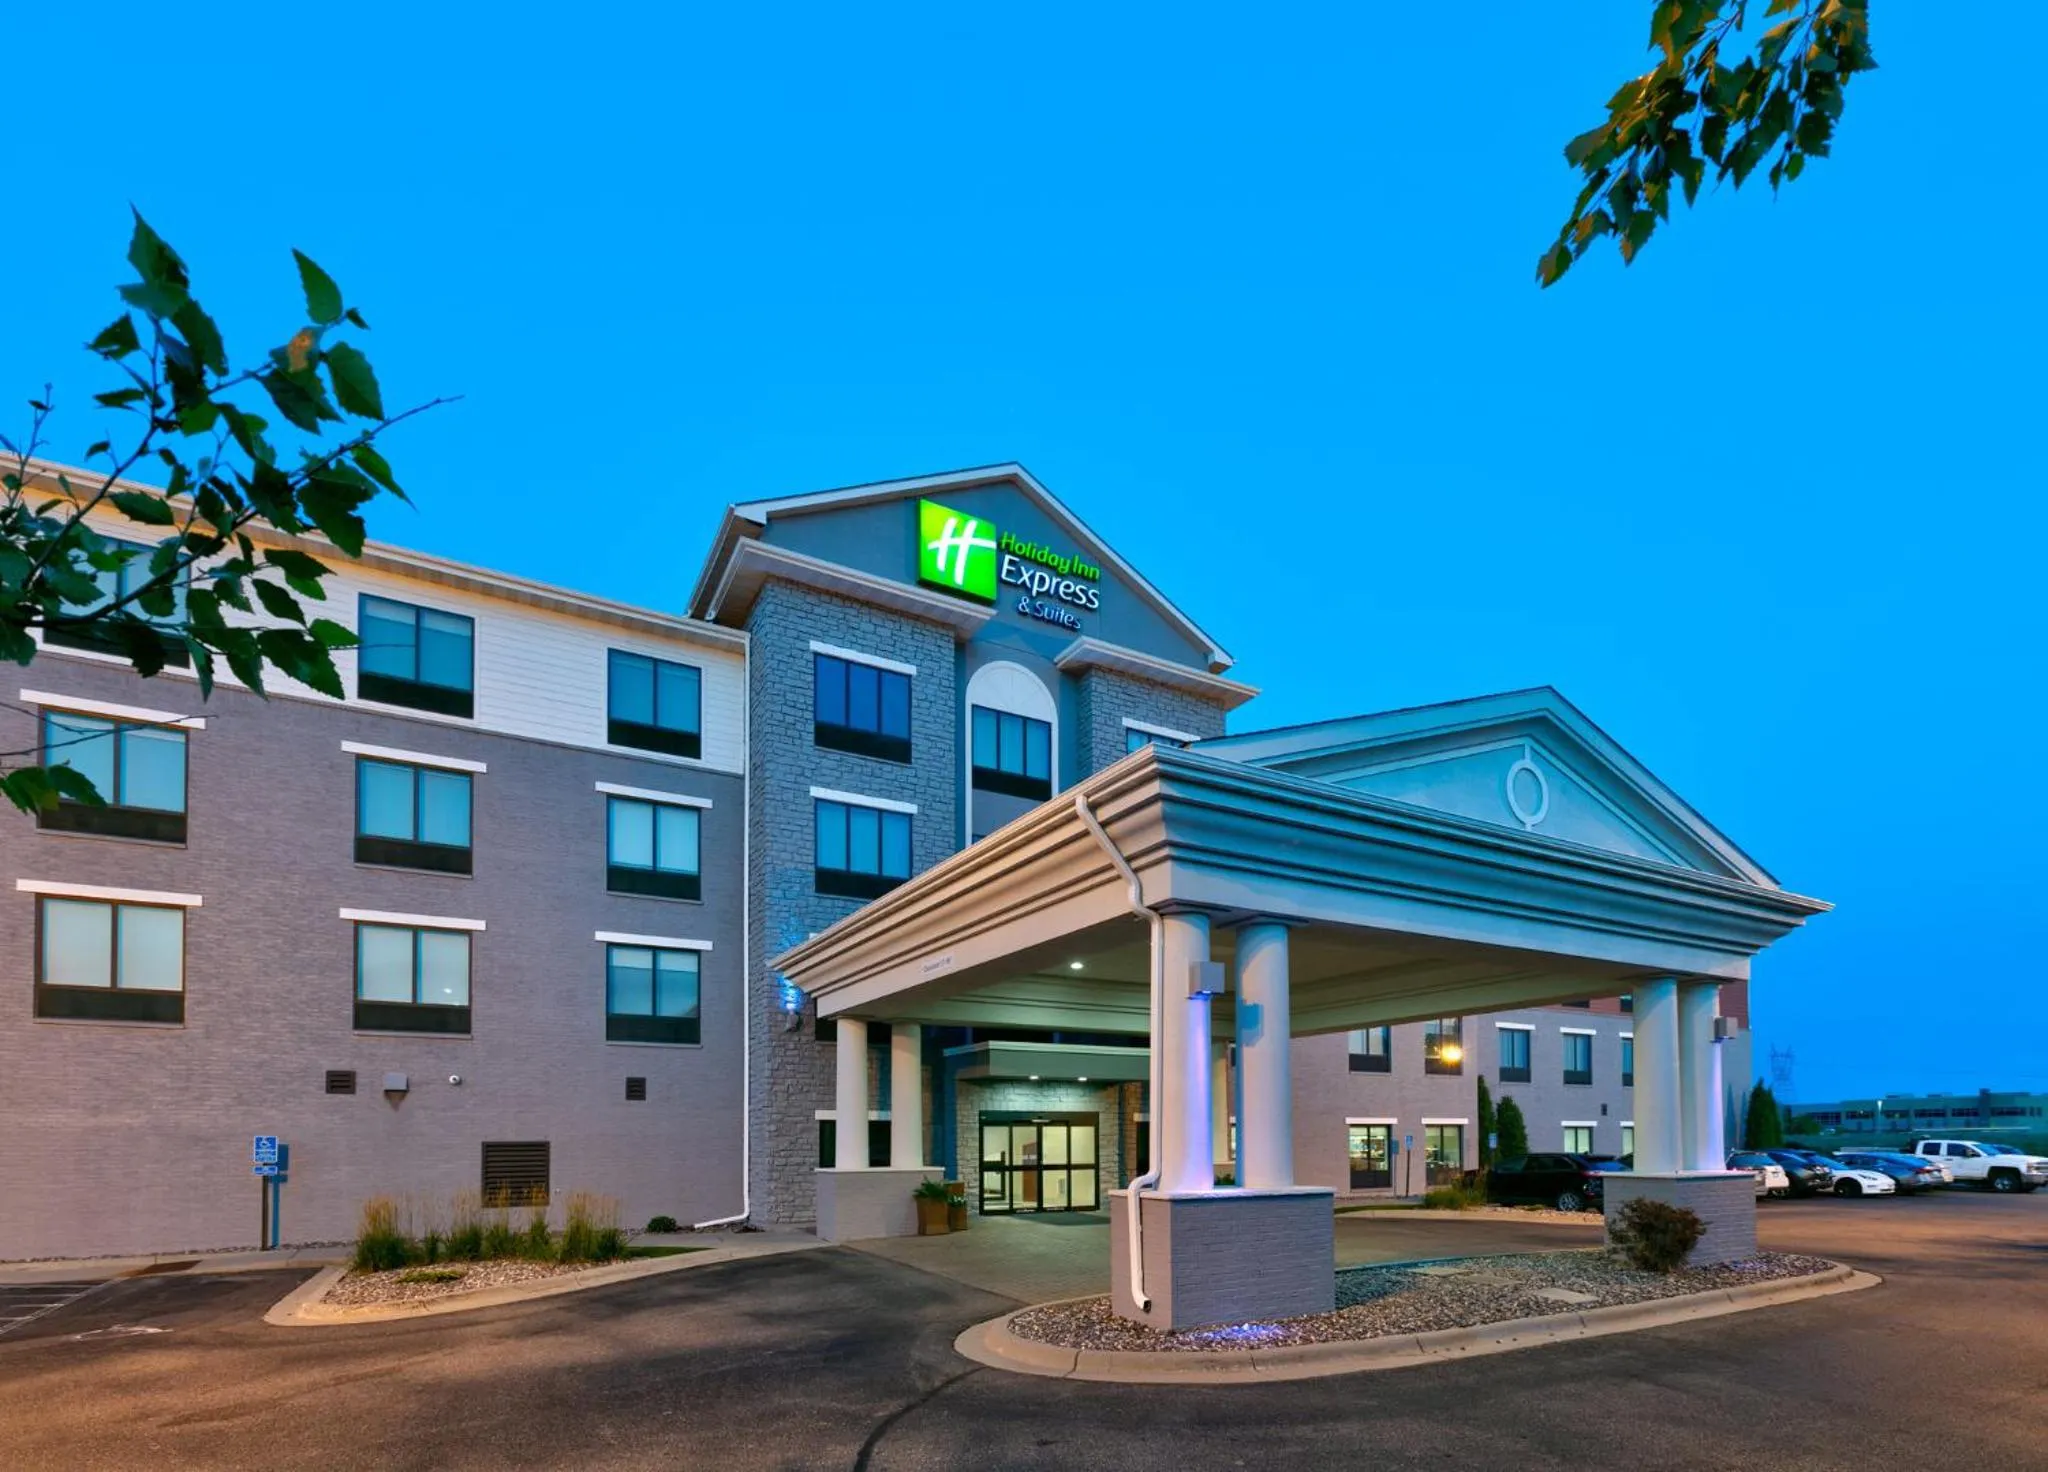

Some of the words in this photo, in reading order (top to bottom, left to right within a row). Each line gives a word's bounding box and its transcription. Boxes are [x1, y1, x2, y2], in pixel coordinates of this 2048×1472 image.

[1000, 531, 1070, 574] Holiday
[1072, 555, 1100, 580] Inn
[1001, 554, 1100, 609] Express
[1018, 596, 1030, 613] &
[1034, 601, 1081, 629] Suites
